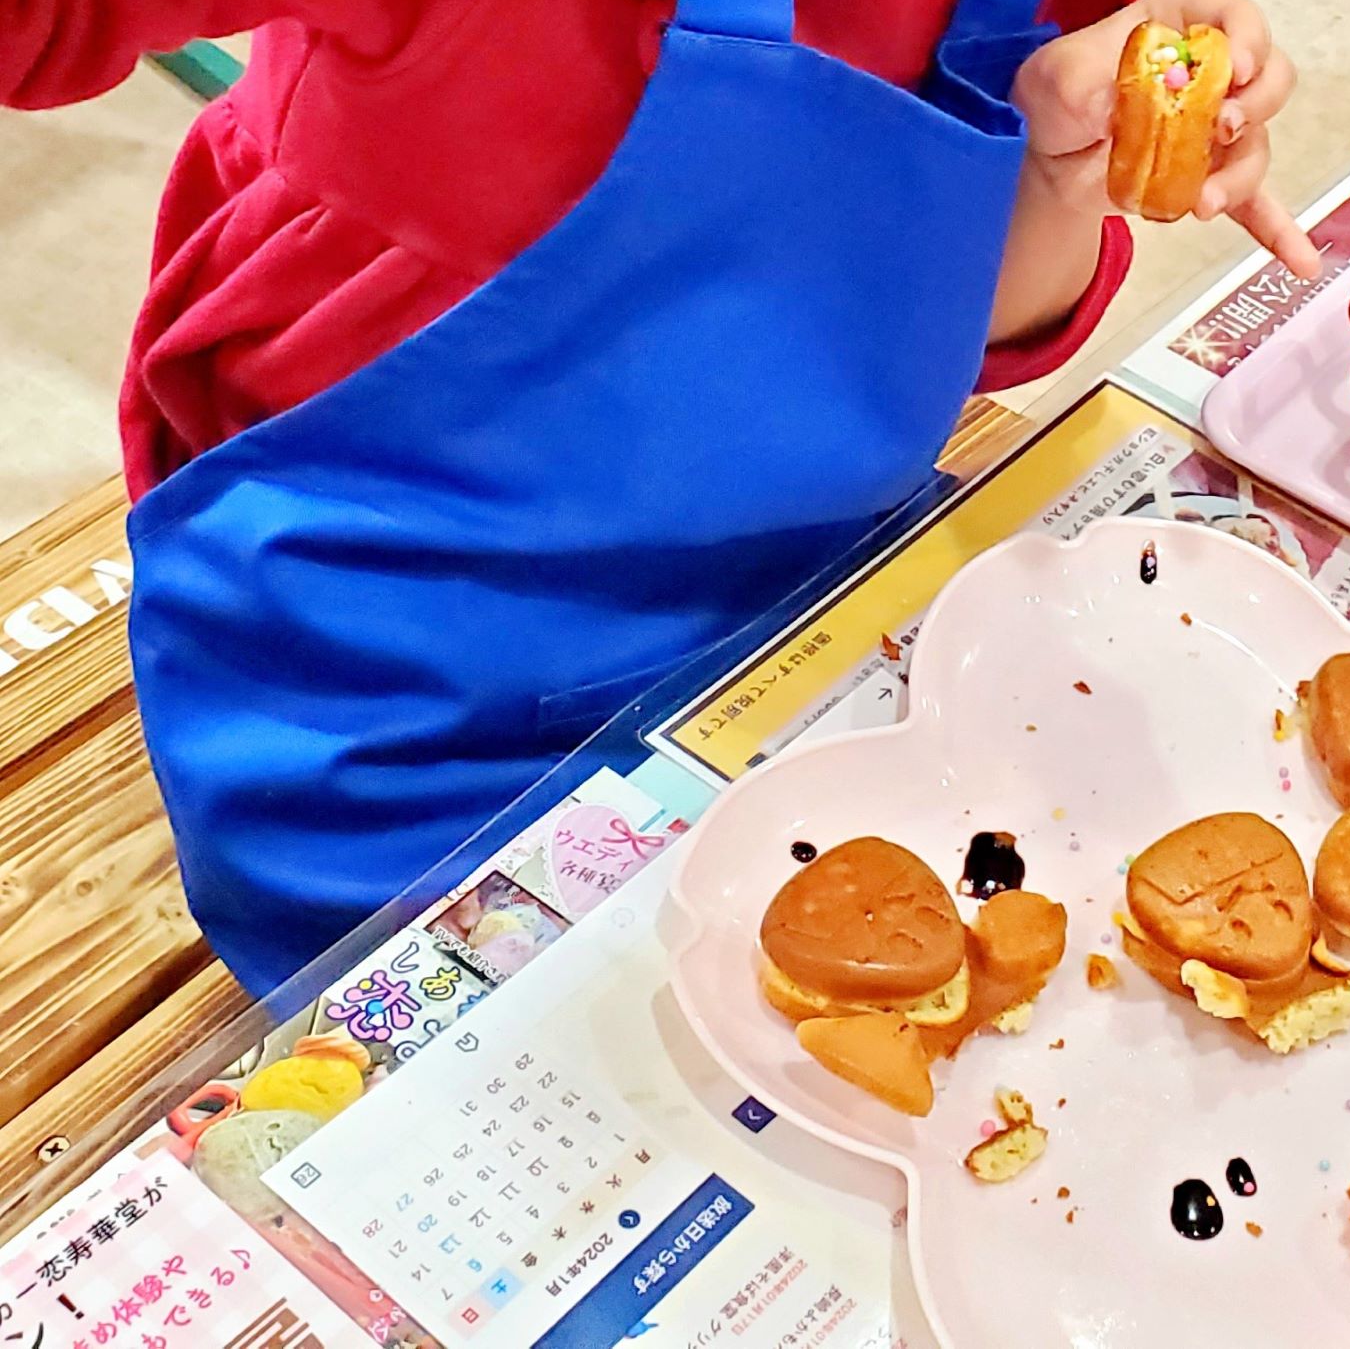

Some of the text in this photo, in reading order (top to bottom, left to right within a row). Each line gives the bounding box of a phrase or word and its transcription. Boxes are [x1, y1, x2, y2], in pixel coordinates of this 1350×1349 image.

[698, 631, 833, 741] 価格はすべて税別です
[459, 1052, 534, 1117] 29 30 31
[362, 1071, 558, 1238] 22 23 24 25 26 27 28
[389, 1092, 582, 1259] 15 16 17 18 19 20 21
[526, 1156, 549, 1177] 10
[468, 1207, 492, 1228] 12
[498, 1181, 521, 1201] 11
[439, 1234, 462, 1254] 13
[461, 1148, 652, 1324] 月 火 水 木 金 土 日
[545, 1233, 614, 1297] 2024年1月
[633, 1195, 734, 1295] 放送日から探す
[411, 1264, 431, 1282] 14
[720, 1246, 794, 1319] 洋風そば食堂
